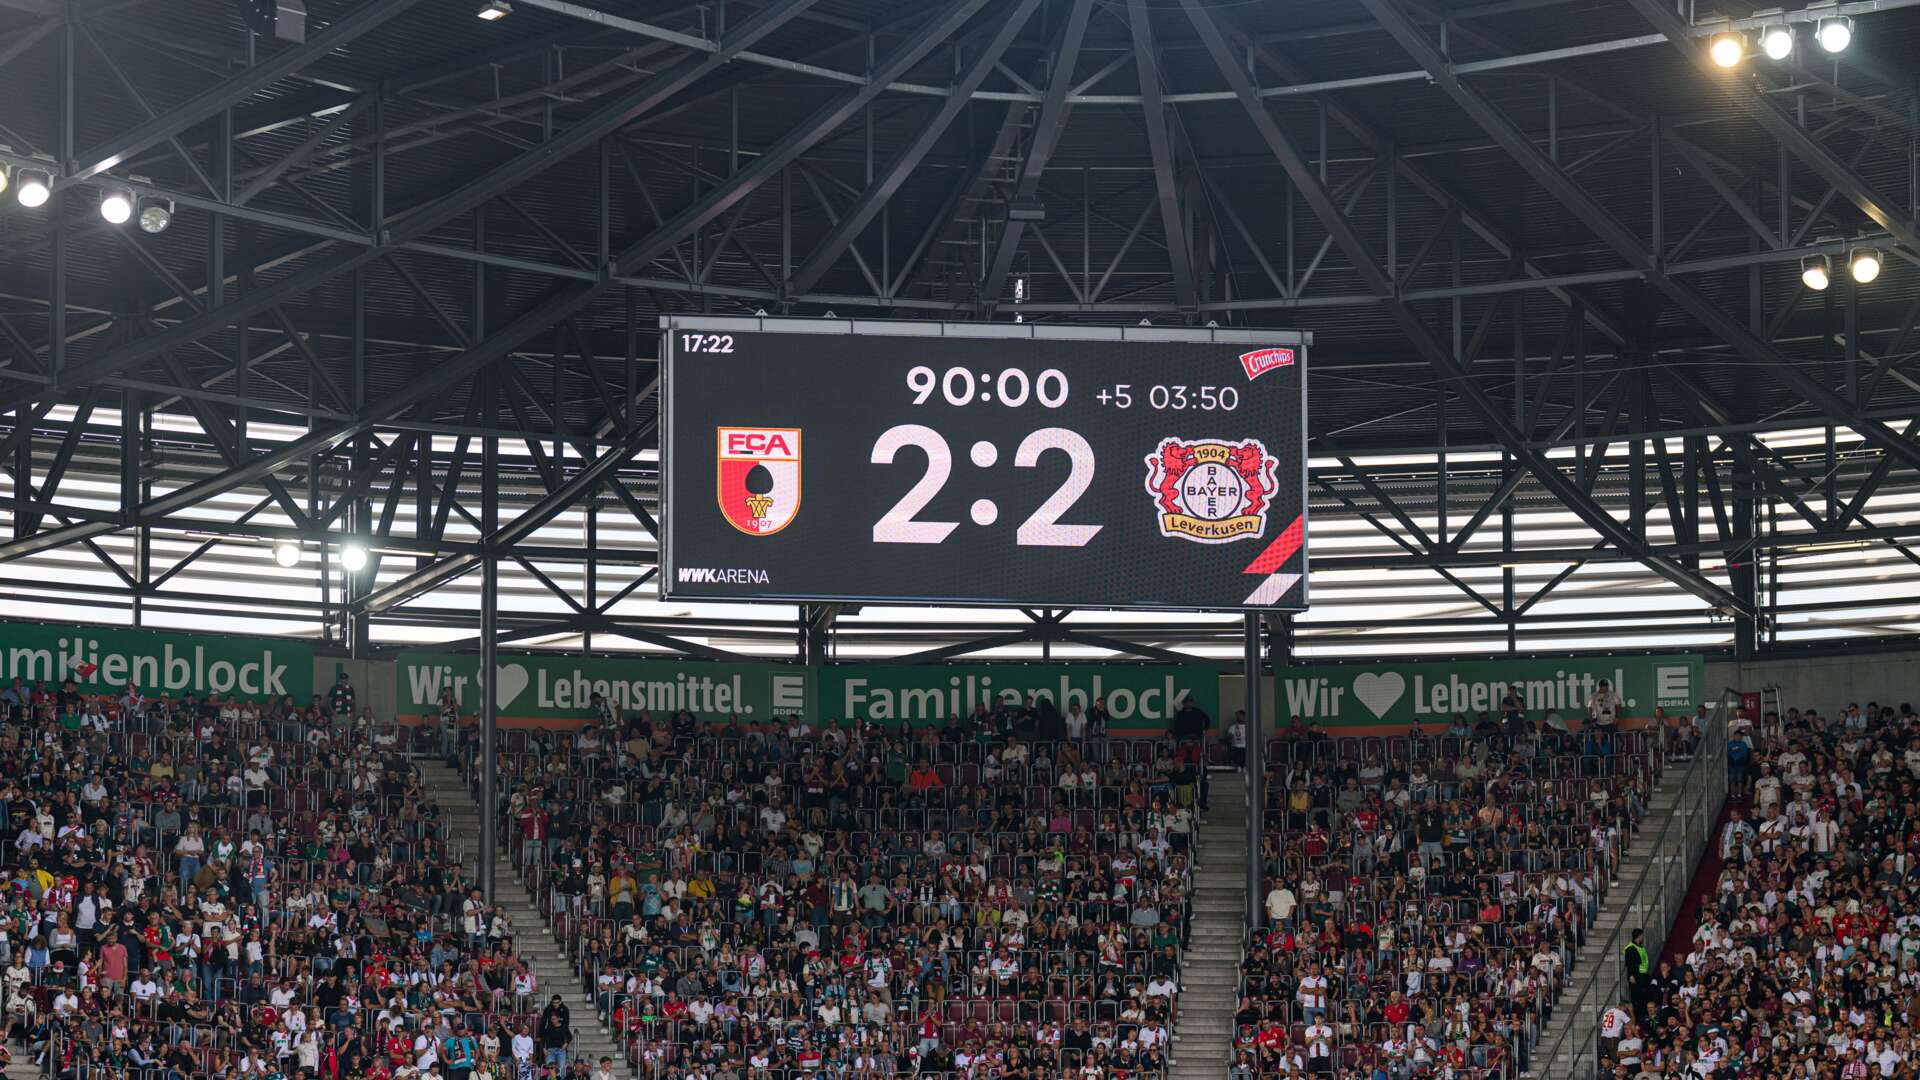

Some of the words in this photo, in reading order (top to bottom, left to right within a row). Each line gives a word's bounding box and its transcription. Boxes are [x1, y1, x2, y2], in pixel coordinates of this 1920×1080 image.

[682, 334, 734, 353] 17:22
[1248, 351, 1291, 372] Crunchips
[906, 365, 1069, 408] 90:00
[1096, 384, 1132, 408] +5
[1150, 385, 1239, 411] 03:50
[728, 433, 791, 455] FCA
[1196, 448, 1225, 459] 1904
[870, 424, 1104, 547] 2:2
[1187, 486, 1238, 496] BAYER
[1207, 466, 1217, 517] BAYER
[746, 520, 772, 529] 1907
[1172, 517, 1253, 536] Leverkusen
[678, 567, 770, 584] WWKARENA
[0, 637, 288, 696] milienblock
[407, 665, 468, 706] Wir
[1285, 677, 1344, 717] Wir
[1414, 669, 1636, 714] Lebenmittl.
[773, 708, 804, 716] EDEKA
[1656, 699, 1691, 707] EDEKA
